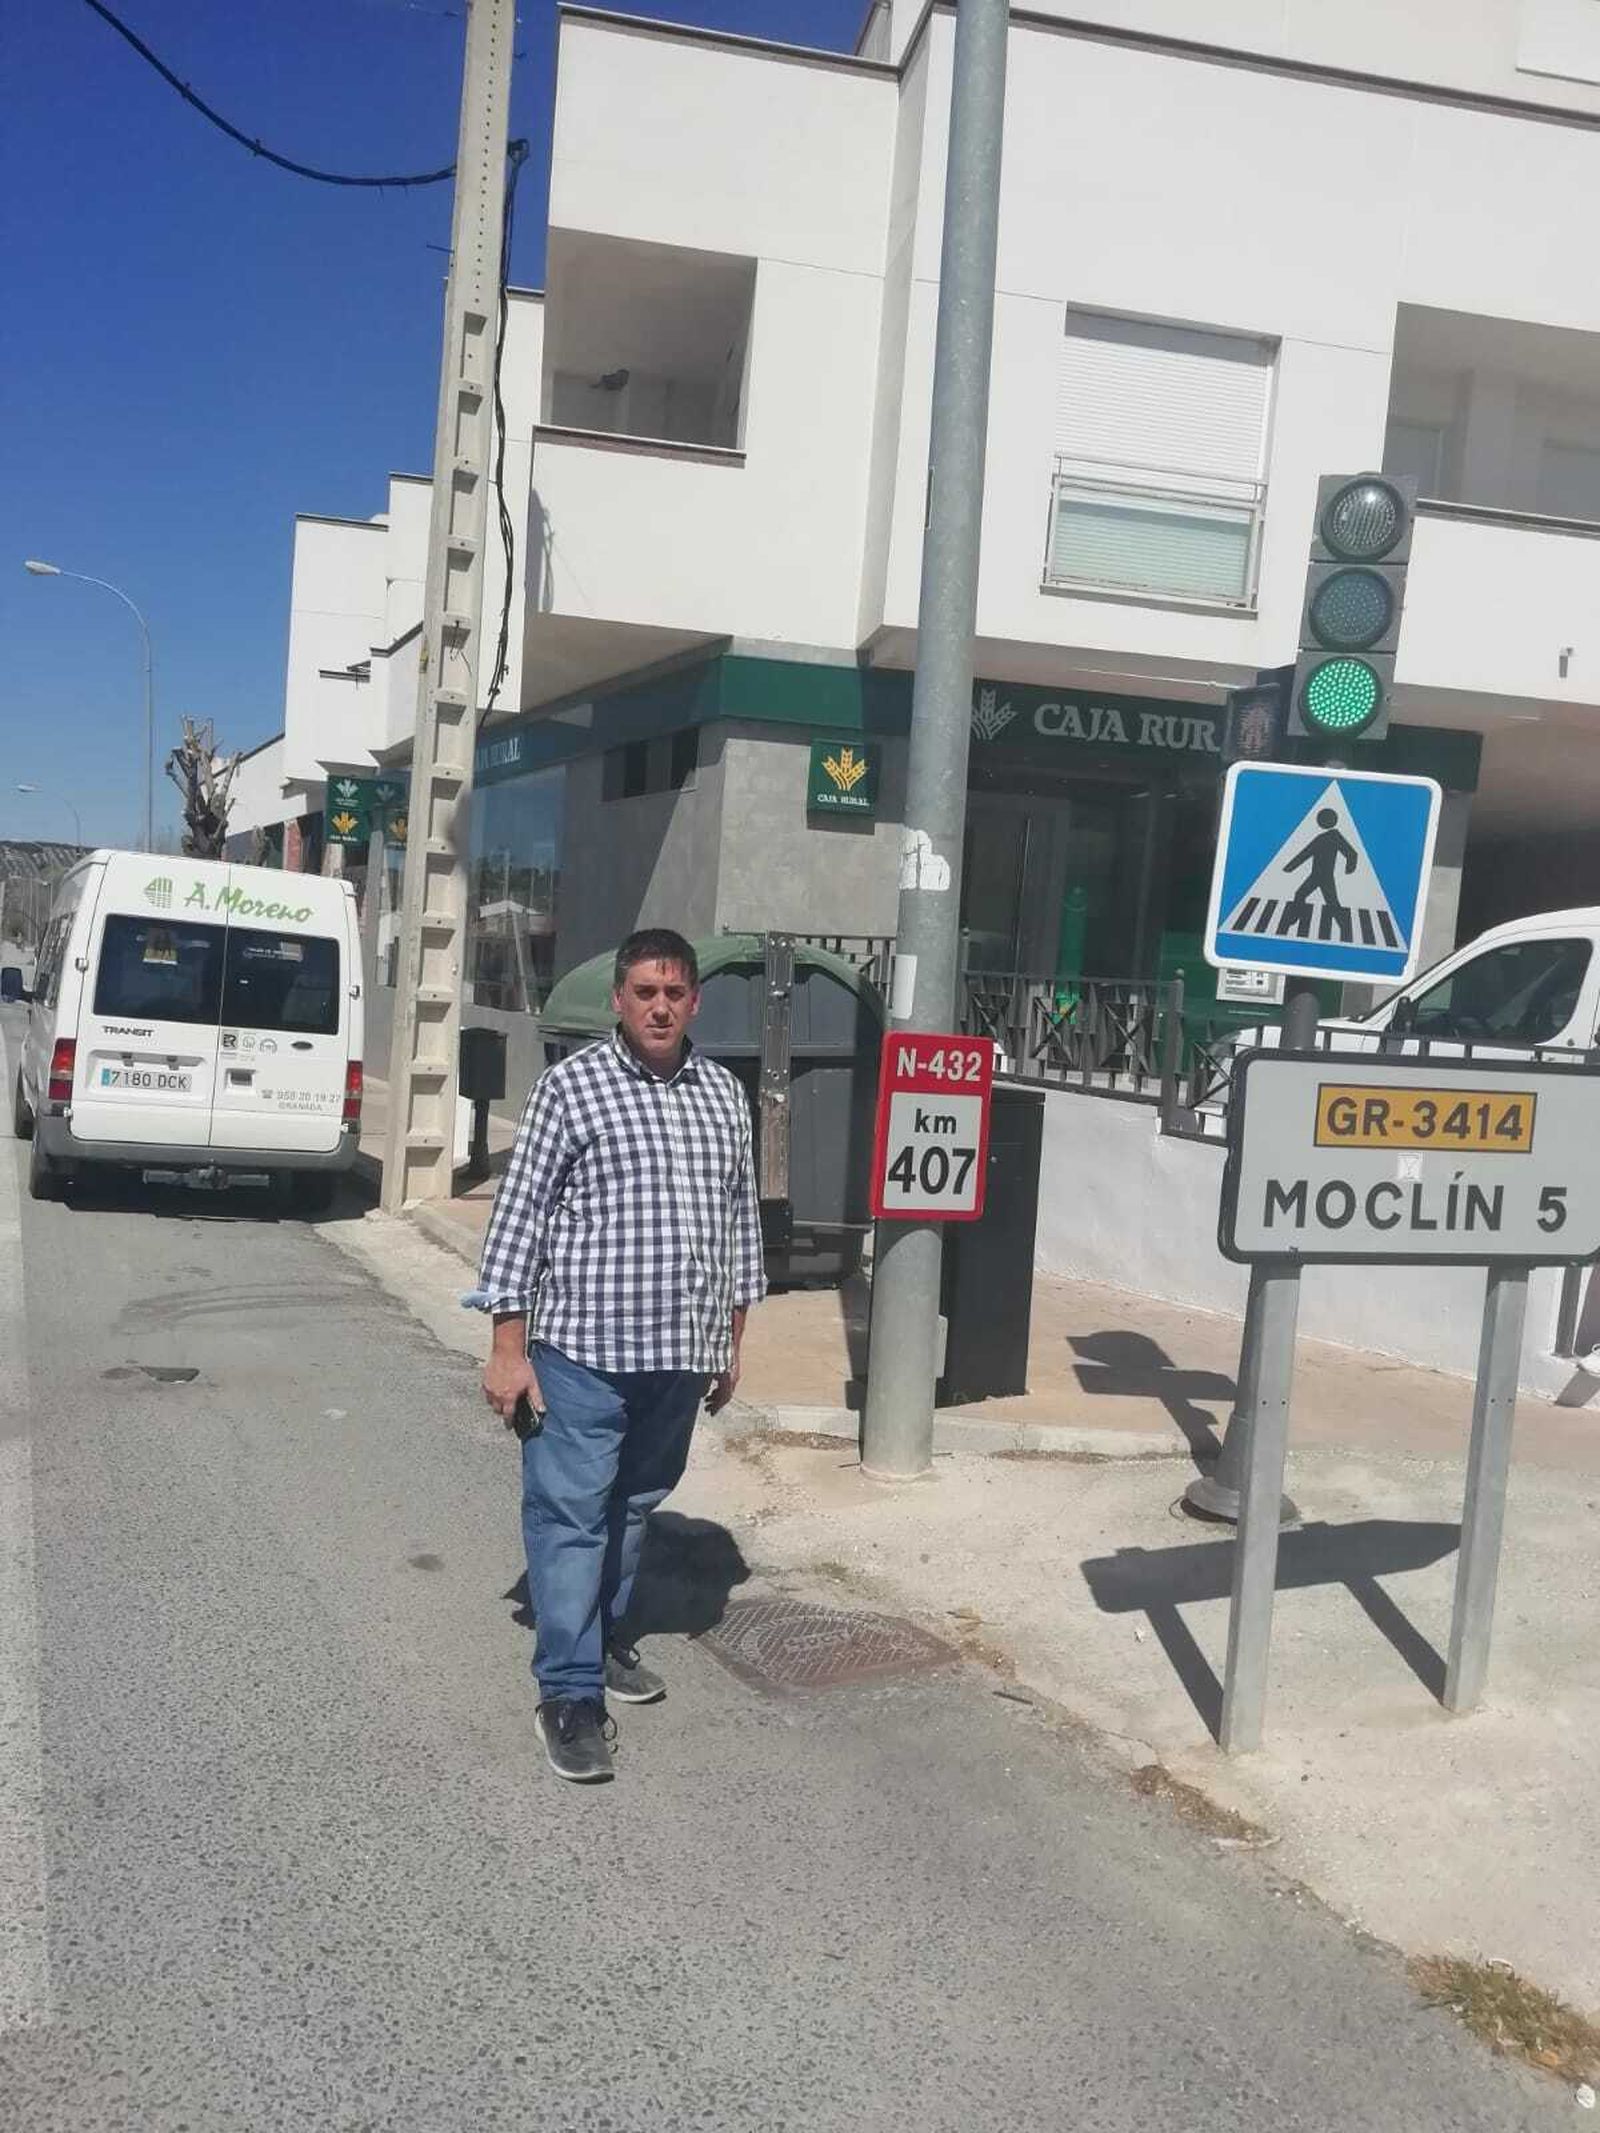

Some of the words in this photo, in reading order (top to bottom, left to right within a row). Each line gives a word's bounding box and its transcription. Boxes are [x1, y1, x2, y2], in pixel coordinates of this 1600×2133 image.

[1034, 704, 1129, 742] CAJA
[1137, 713, 1220, 751] RUR
[102, 1025, 155, 1037] TRANSIT
[111, 1071, 151, 1087] 7180
[157, 1074, 187, 1089] DCK
[897, 1047, 982, 1082] N-432
[914, 1108, 957, 1135] km
[1327, 1096, 1523, 1141] GR-3414
[887, 1145, 976, 1195] 407
[1263, 1171, 1504, 1231] MOCLÍN
[1536, 1186, 1568, 1233] 5
